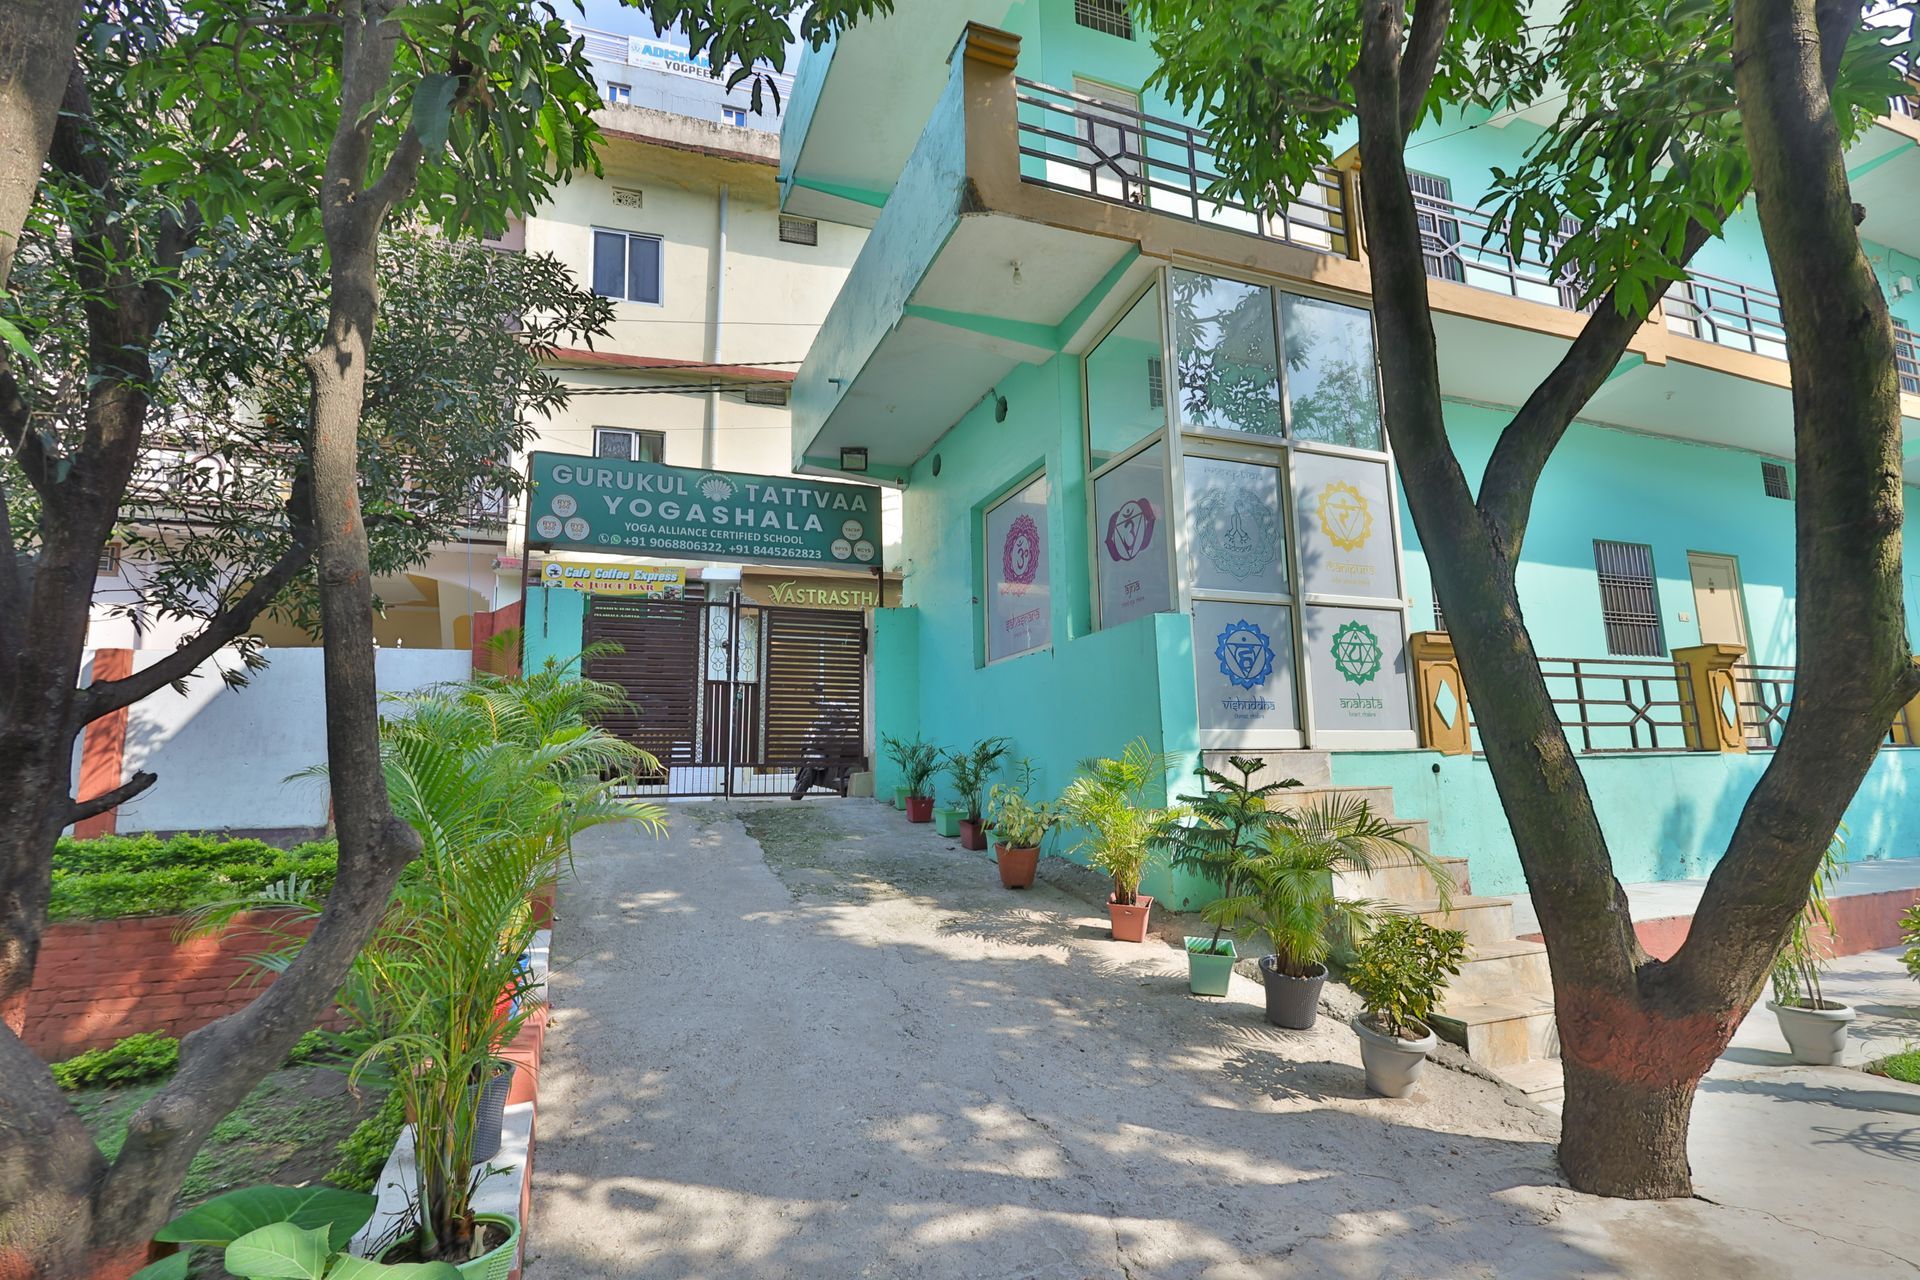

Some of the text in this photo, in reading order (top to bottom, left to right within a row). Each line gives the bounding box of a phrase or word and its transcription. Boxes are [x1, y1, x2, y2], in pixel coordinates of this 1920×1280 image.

[642, 45, 710, 68] ADISHAK
[665, 60, 725, 82] YOGPEEH
[552, 464, 688, 496] GURUKUL
[745, 484, 868, 512] TATTVAA
[602, 495, 824, 532] YOGASHALA
[625, 522, 804, 545] YOGA ALLIANCE CERTIFIED SCHOOL
[624, 536, 822, 559] +91 9068806322, +91 8445262823
[565, 567, 590, 578] Cafe
[594, 567, 630, 580] Coffee
[634, 569, 679, 583] Express
[573, 580, 584, 589] &
[628, 582, 654, 591] BAR
[1221, 695, 1275, 711] vishuddha
[1339, 693, 1383, 709] anahata
